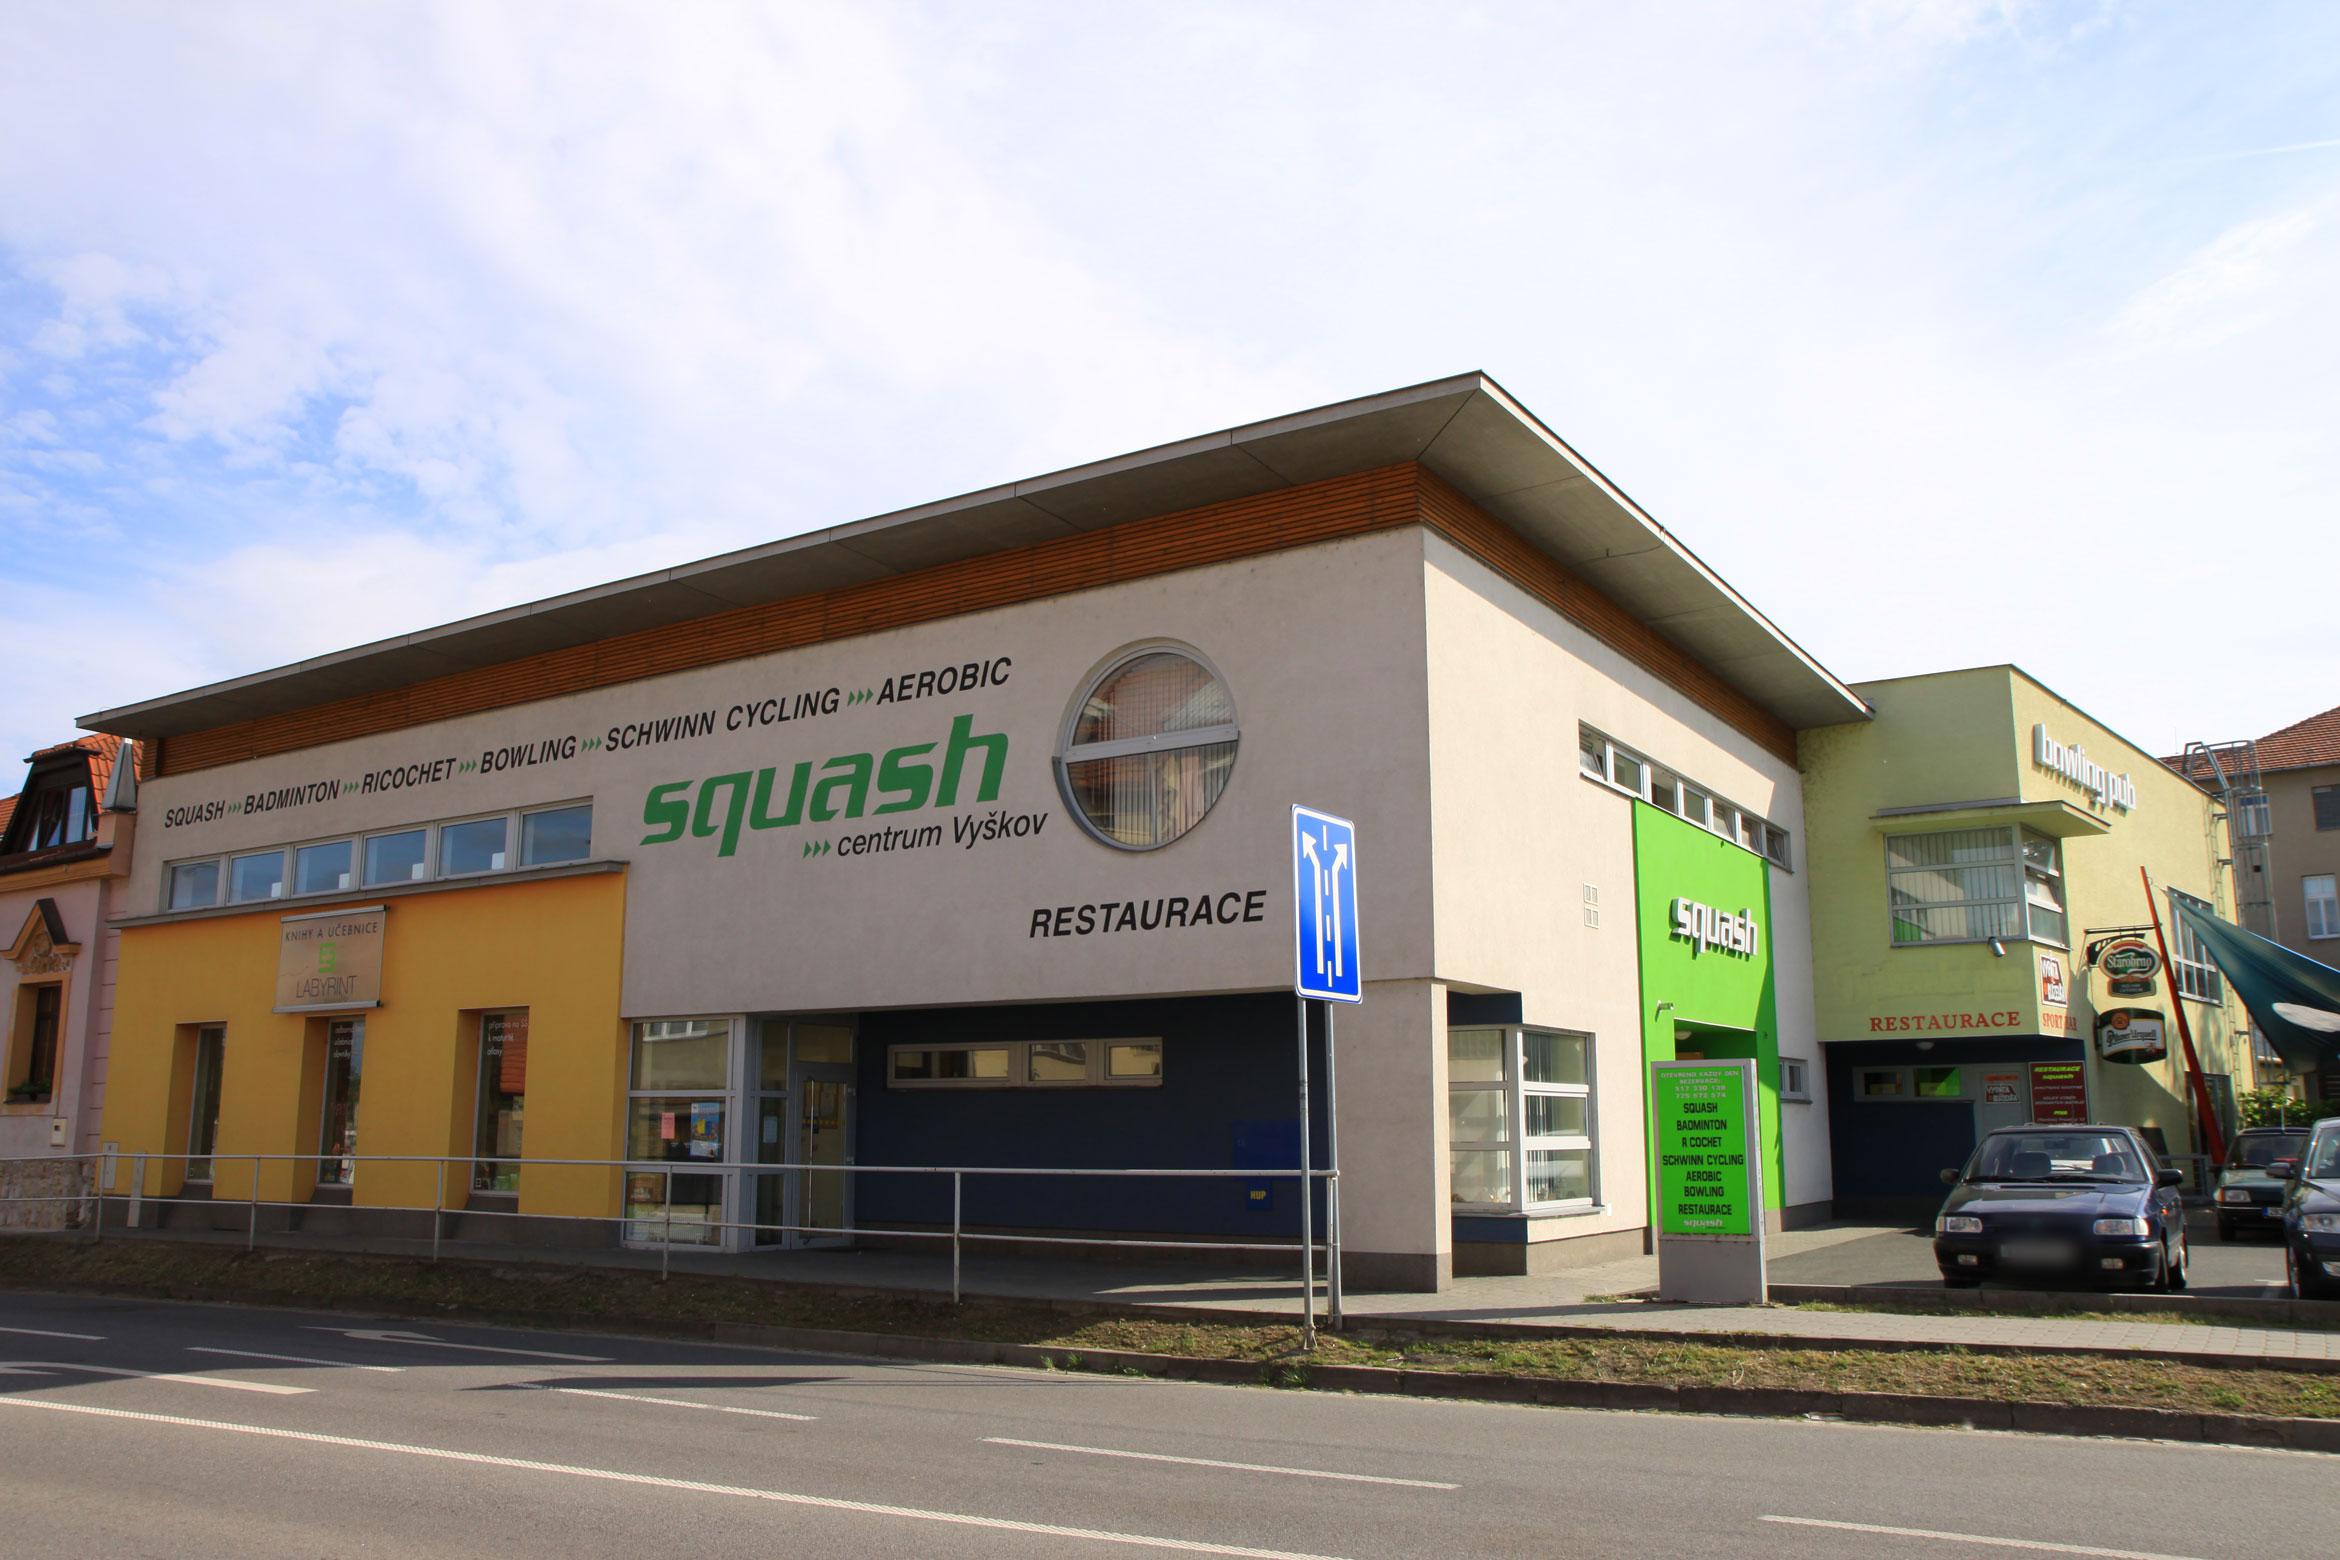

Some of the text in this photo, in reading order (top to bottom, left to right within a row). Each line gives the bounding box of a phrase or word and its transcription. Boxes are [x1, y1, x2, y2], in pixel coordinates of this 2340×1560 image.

[164, 656, 1012, 828] SQUASH BADMINTON RICOCHET BOWLING SCHWINN CYCLING AEROBIC
[2033, 722, 2137, 810] bowling pub
[639, 713, 1009, 858] squash
[837, 810, 1048, 857] centrum Vyškov
[1029, 890, 1266, 938] RESTAURACE
[285, 921, 378, 941] KNIHY A UČEBNICE
[1672, 896, 1758, 956] squash
[2107, 953, 2152, 969] Starobrno
[296, 975, 357, 998] LABYRINT
[1870, 1011, 2021, 1032] RESTAURACE
[2042, 1012, 2063, 1030] SPORT
[1683, 1103, 1718, 1113] SQUASH
[1676, 1119, 1727, 1130] BADMINTON
[1662, 1154, 1744, 1166] SCHWINN CYCLING
[1686, 1171, 1722, 1181] AEROBIC
[1684, 1186, 1724, 1197] BOWLING
[1678, 1203, 1732, 1215] RESTAURACE
